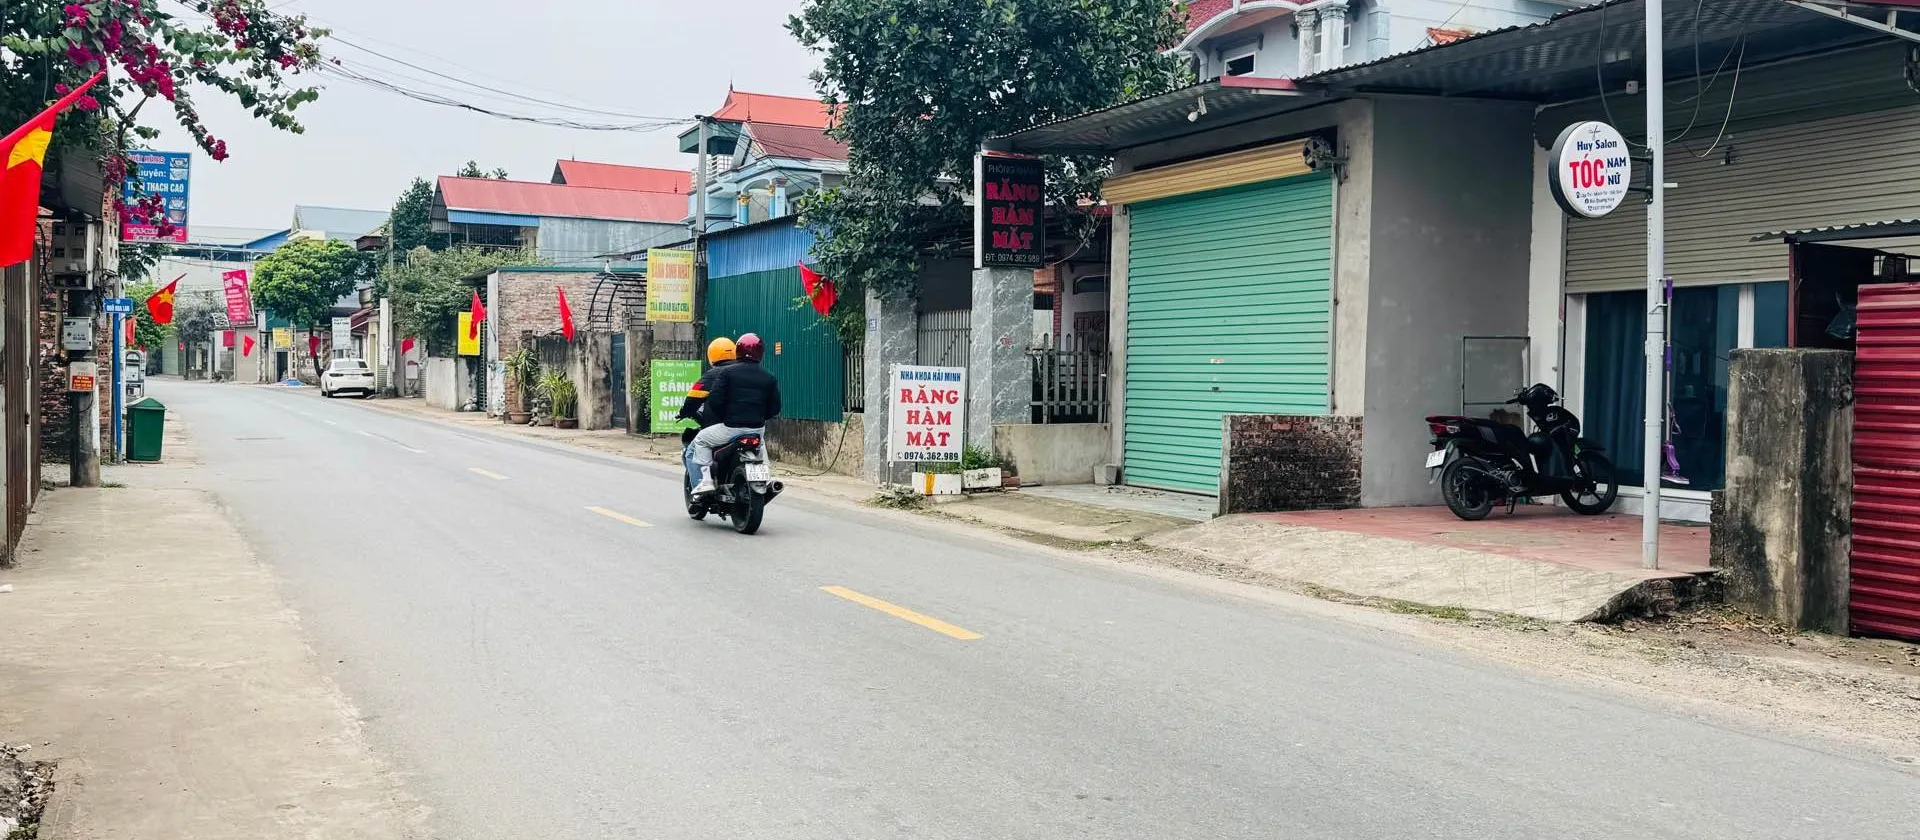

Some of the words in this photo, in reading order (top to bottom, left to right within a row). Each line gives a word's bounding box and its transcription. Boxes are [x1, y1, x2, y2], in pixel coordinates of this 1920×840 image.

[1577, 141, 1593, 151] Huy
[1595, 139, 1617, 149] Salon
[1569, 153, 1605, 189] TÓC
[1607, 156, 1626, 168] NAM
[170, 183, 184, 193] CAO
[985, 178, 1040, 201] RĂNG
[992, 226, 1033, 252] MẶT
[997, 254, 1014, 262] 0974
[901, 371, 913, 380] NHA
[915, 371, 931, 380] KHOA
[944, 372, 960, 382] MINH
[662, 396, 686, 407] SIN
[901, 384, 959, 404] RĂNG
[906, 407, 952, 425] HÀM
[906, 427, 950, 450] MẶT
[904, 451, 959, 460] 0974.362.989
